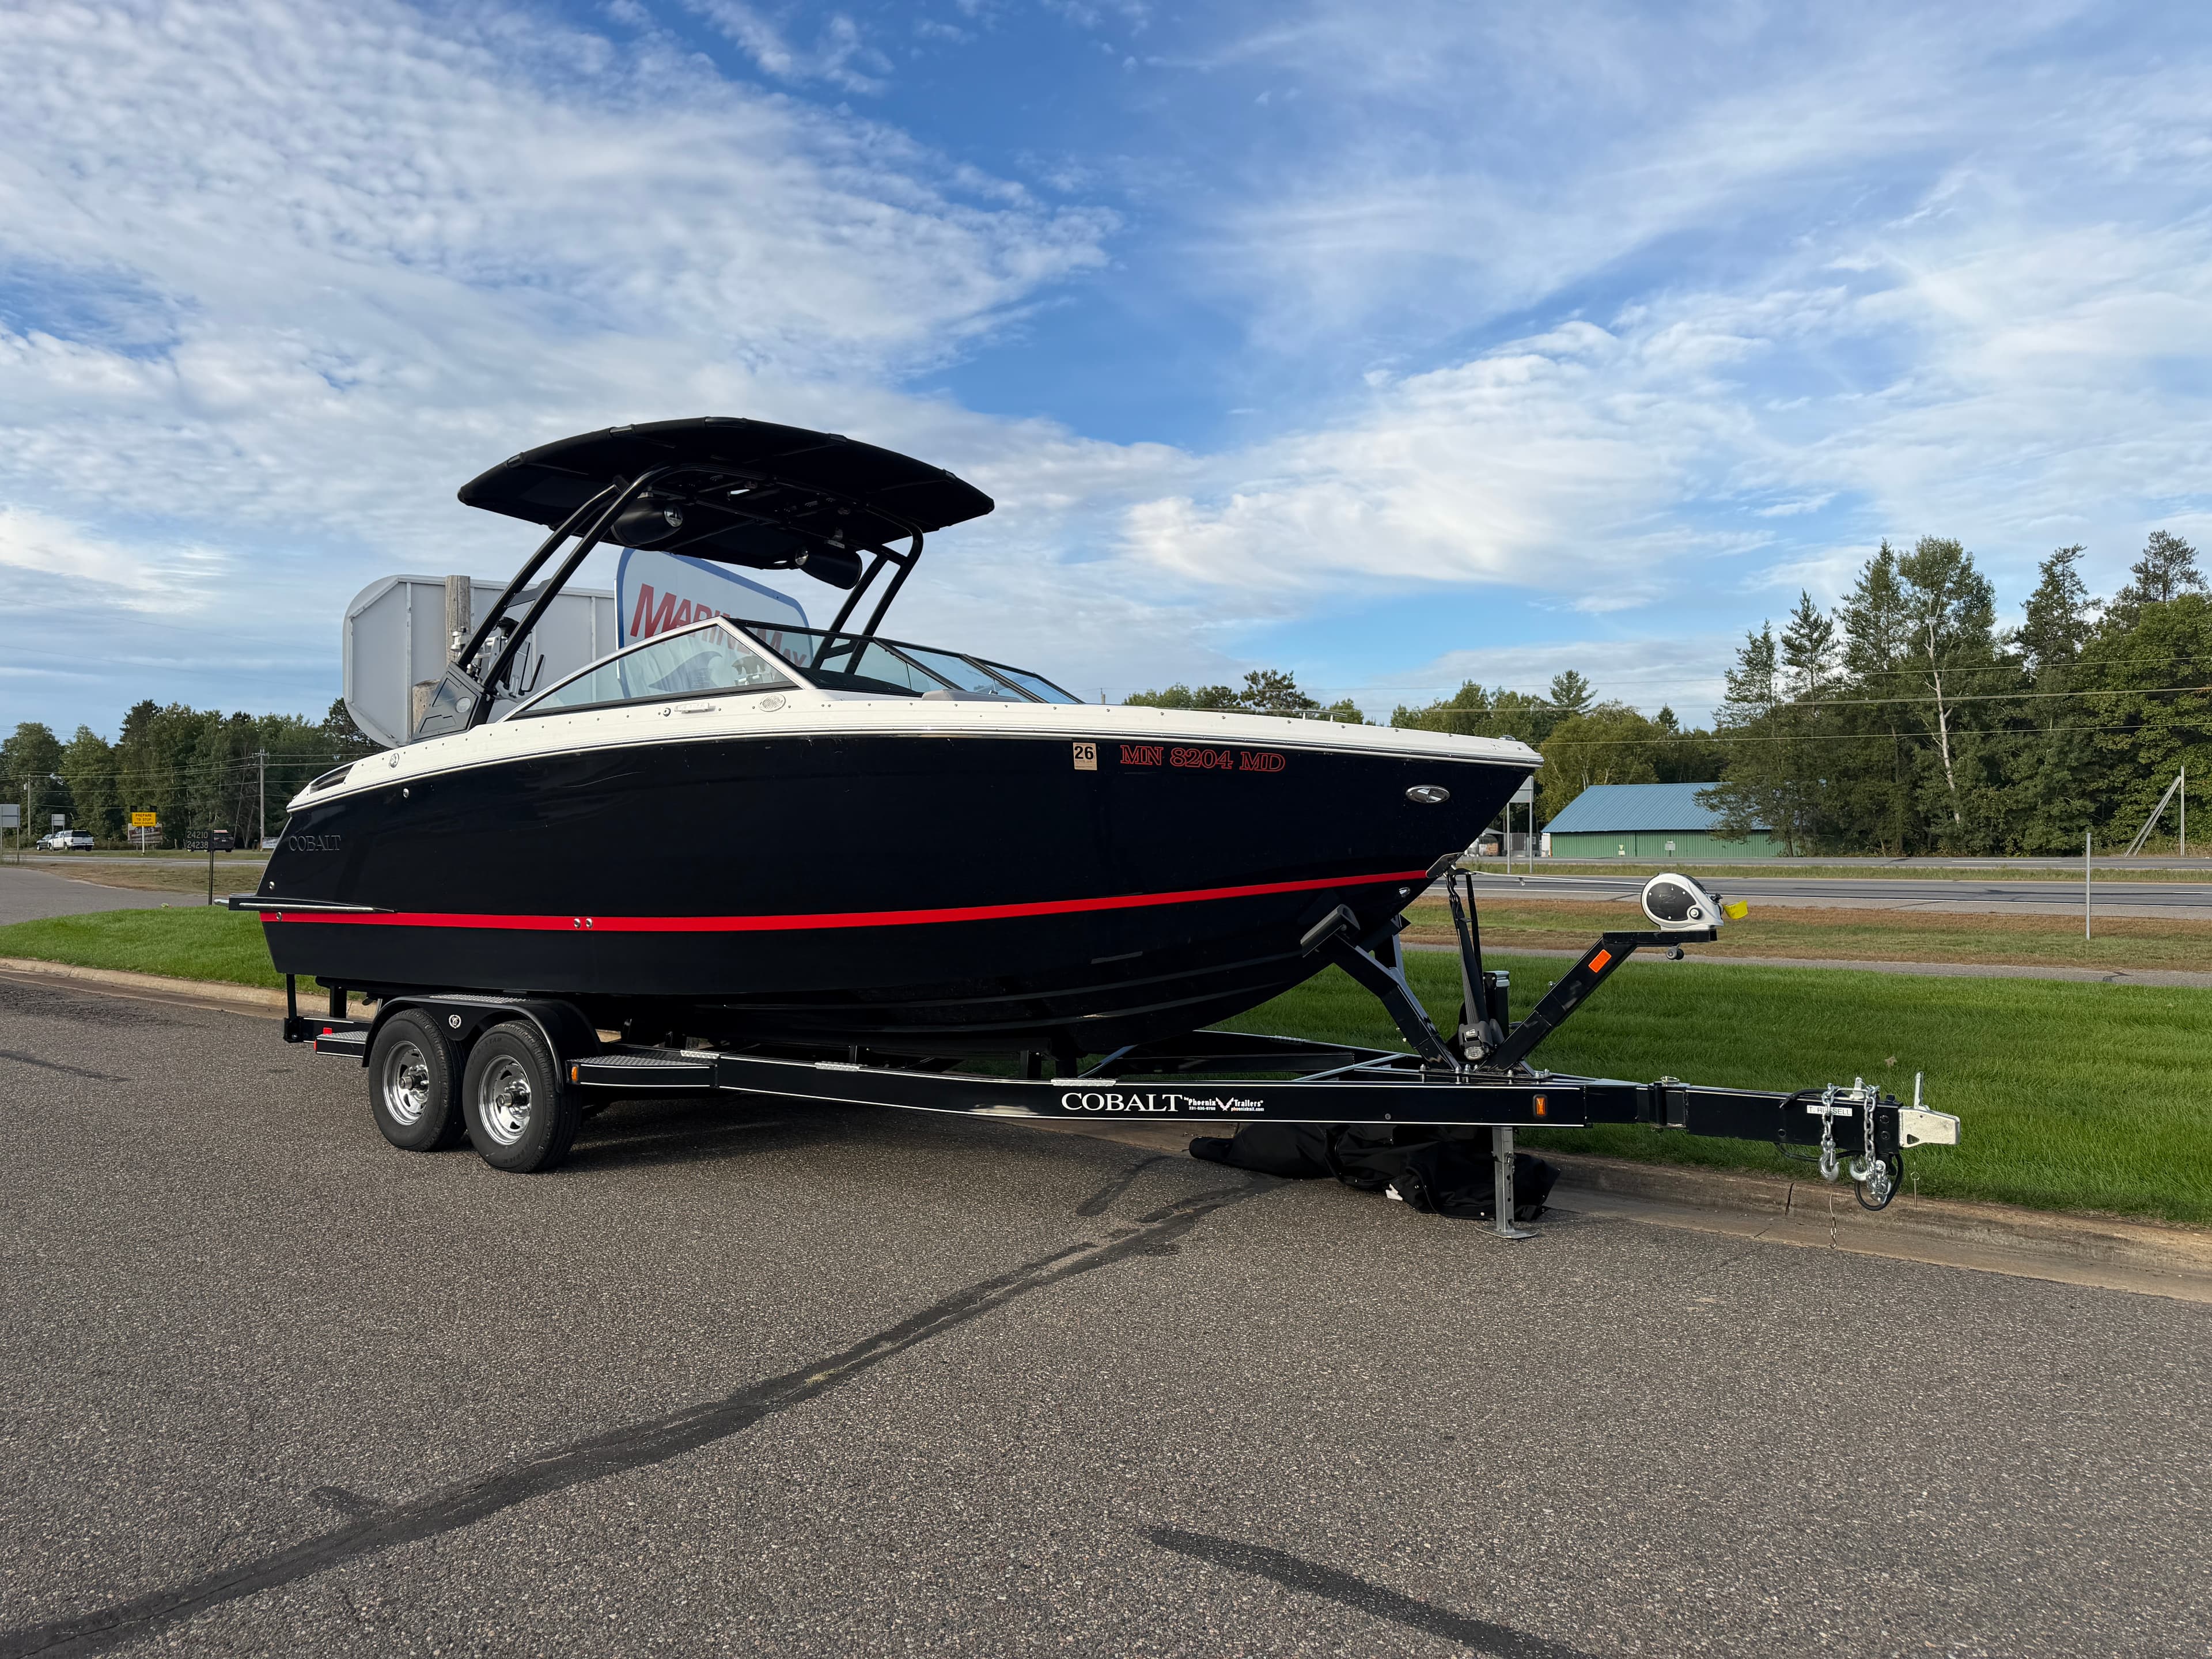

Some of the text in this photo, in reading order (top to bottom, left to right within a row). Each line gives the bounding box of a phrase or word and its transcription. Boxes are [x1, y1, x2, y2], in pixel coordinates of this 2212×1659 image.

[1074, 746, 1094, 759] 26
[1120, 745, 1286, 772] MN 8204 MD
[187, 831, 208, 839] 24210
[187, 840, 209, 849] 24238
[289, 835, 341, 851] COBALT
[1062, 1093, 1183, 1111] COBALT
[1817, 1107, 1851, 1115] RUSELL
